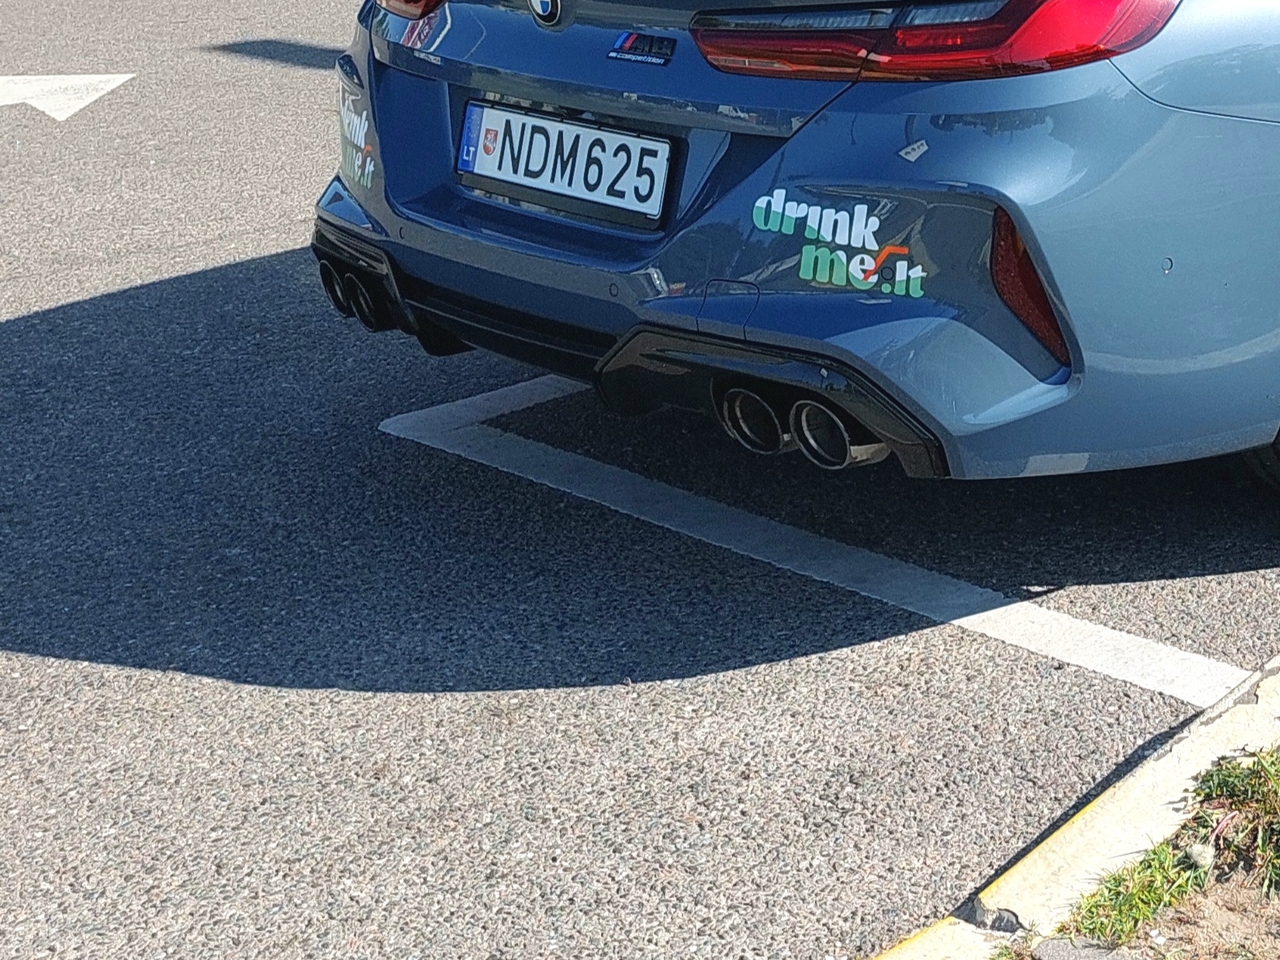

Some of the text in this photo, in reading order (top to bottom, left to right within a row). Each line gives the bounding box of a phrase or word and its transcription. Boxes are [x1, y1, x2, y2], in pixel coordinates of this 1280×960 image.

[617, 52, 665, 64] competition
[463, 145, 475, 162] LT
[753, 189, 880, 251] drink
[799, 244, 928, 298] me.lt
